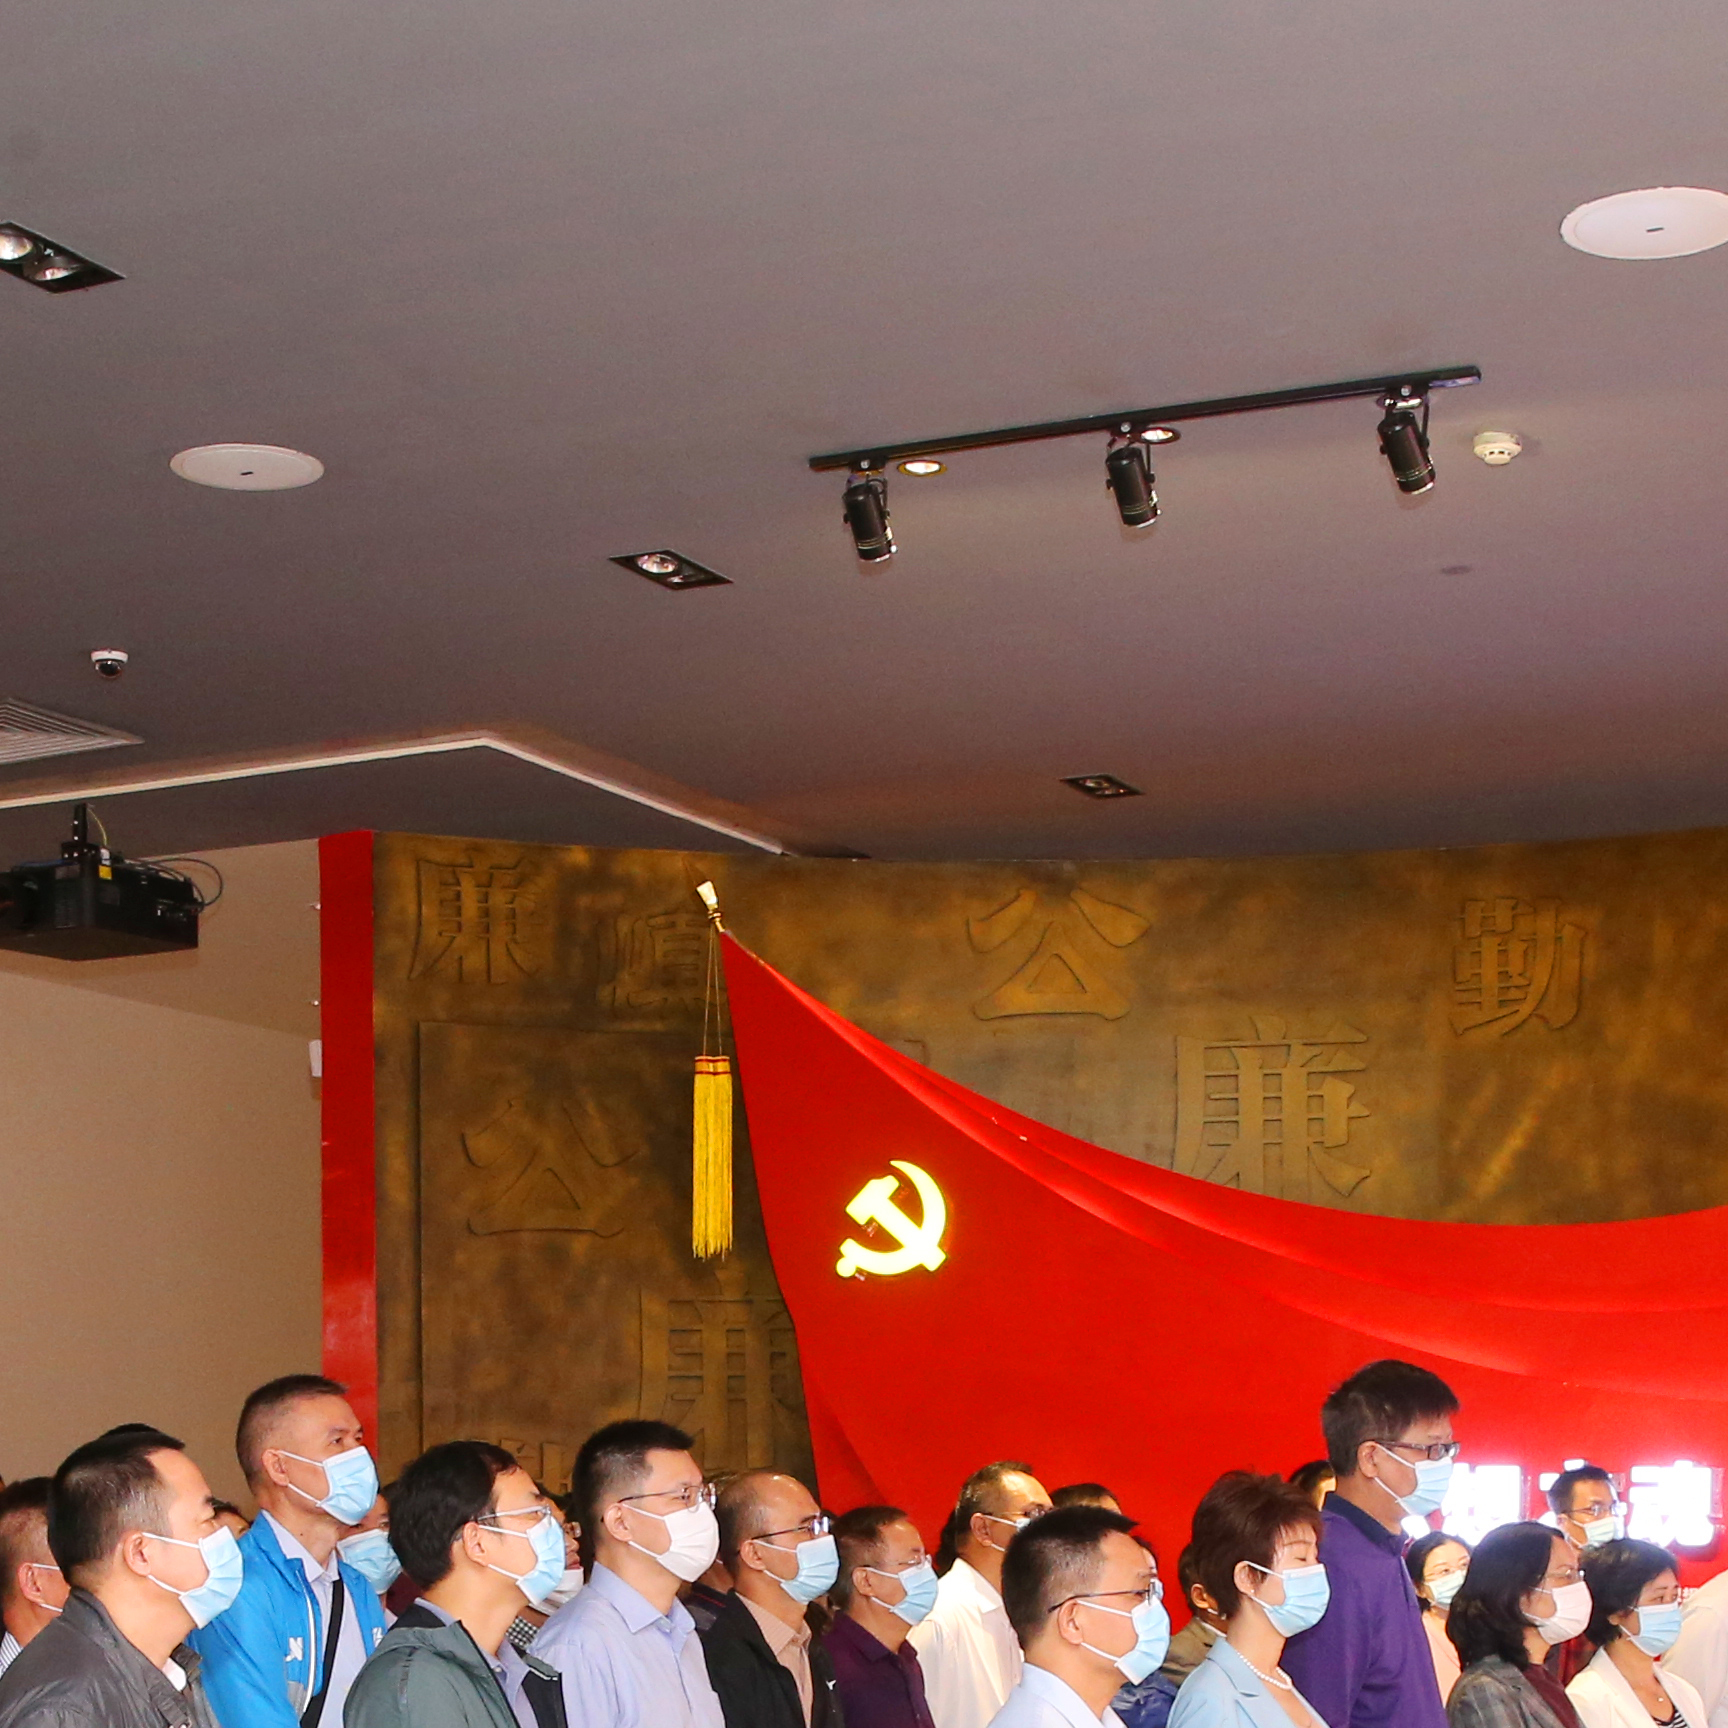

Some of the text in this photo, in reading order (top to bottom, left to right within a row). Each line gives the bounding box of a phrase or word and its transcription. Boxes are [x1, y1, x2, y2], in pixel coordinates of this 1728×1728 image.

[408, 854, 543, 987] 廉
[967, 886, 1151, 1022] 公
[1453, 897, 1591, 1037] 勤
[461, 1099, 639, 1239] 公
[1174, 1014, 1372, 1199] 廉
